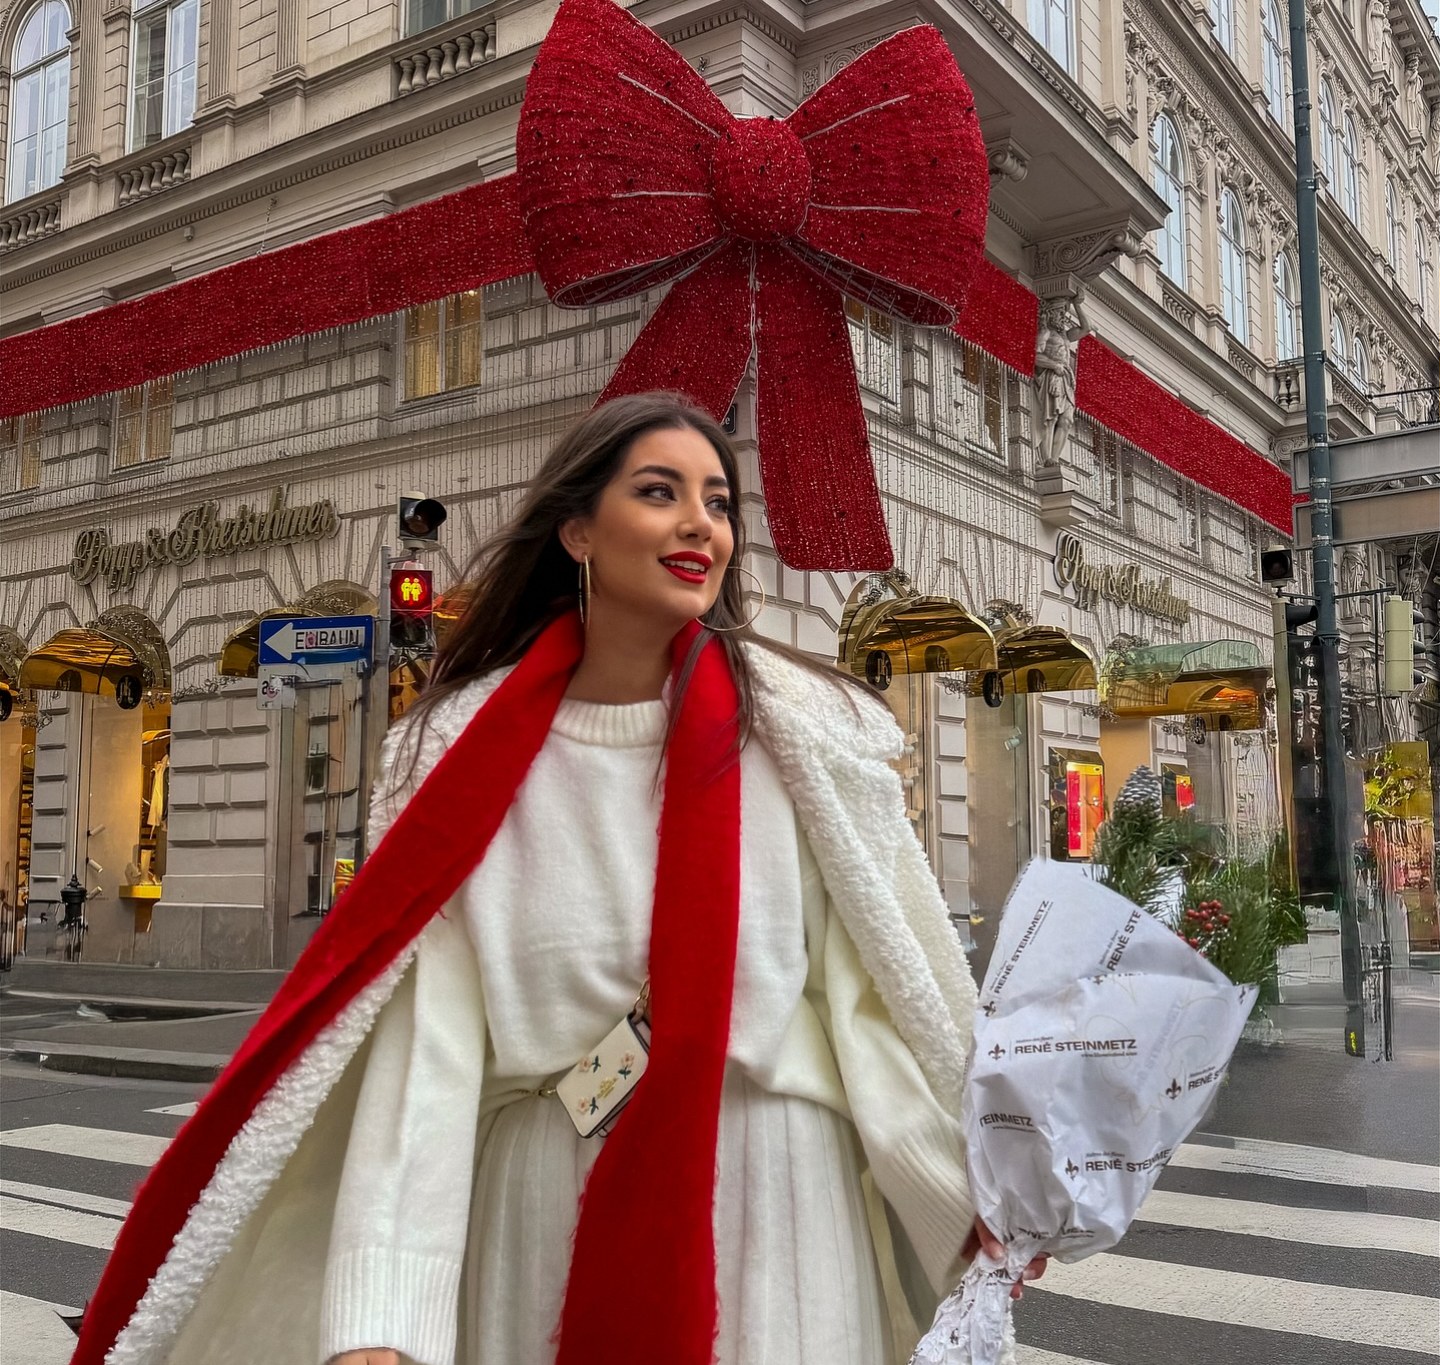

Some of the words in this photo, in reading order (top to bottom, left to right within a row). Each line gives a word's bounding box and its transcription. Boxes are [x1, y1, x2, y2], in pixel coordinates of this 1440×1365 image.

[994, 963, 1014, 994] RENÉ
[1011, 900, 1049, 962] STEINMETZ
[1106, 935, 1130, 972] RENÉ
[1124, 910, 1141, 934] STE
[1015, 1041, 1052, 1054] RENÉ
[1055, 1039, 1137, 1052] STEINMETZ
[1086, 1158, 1122, 1172] RENÉ
